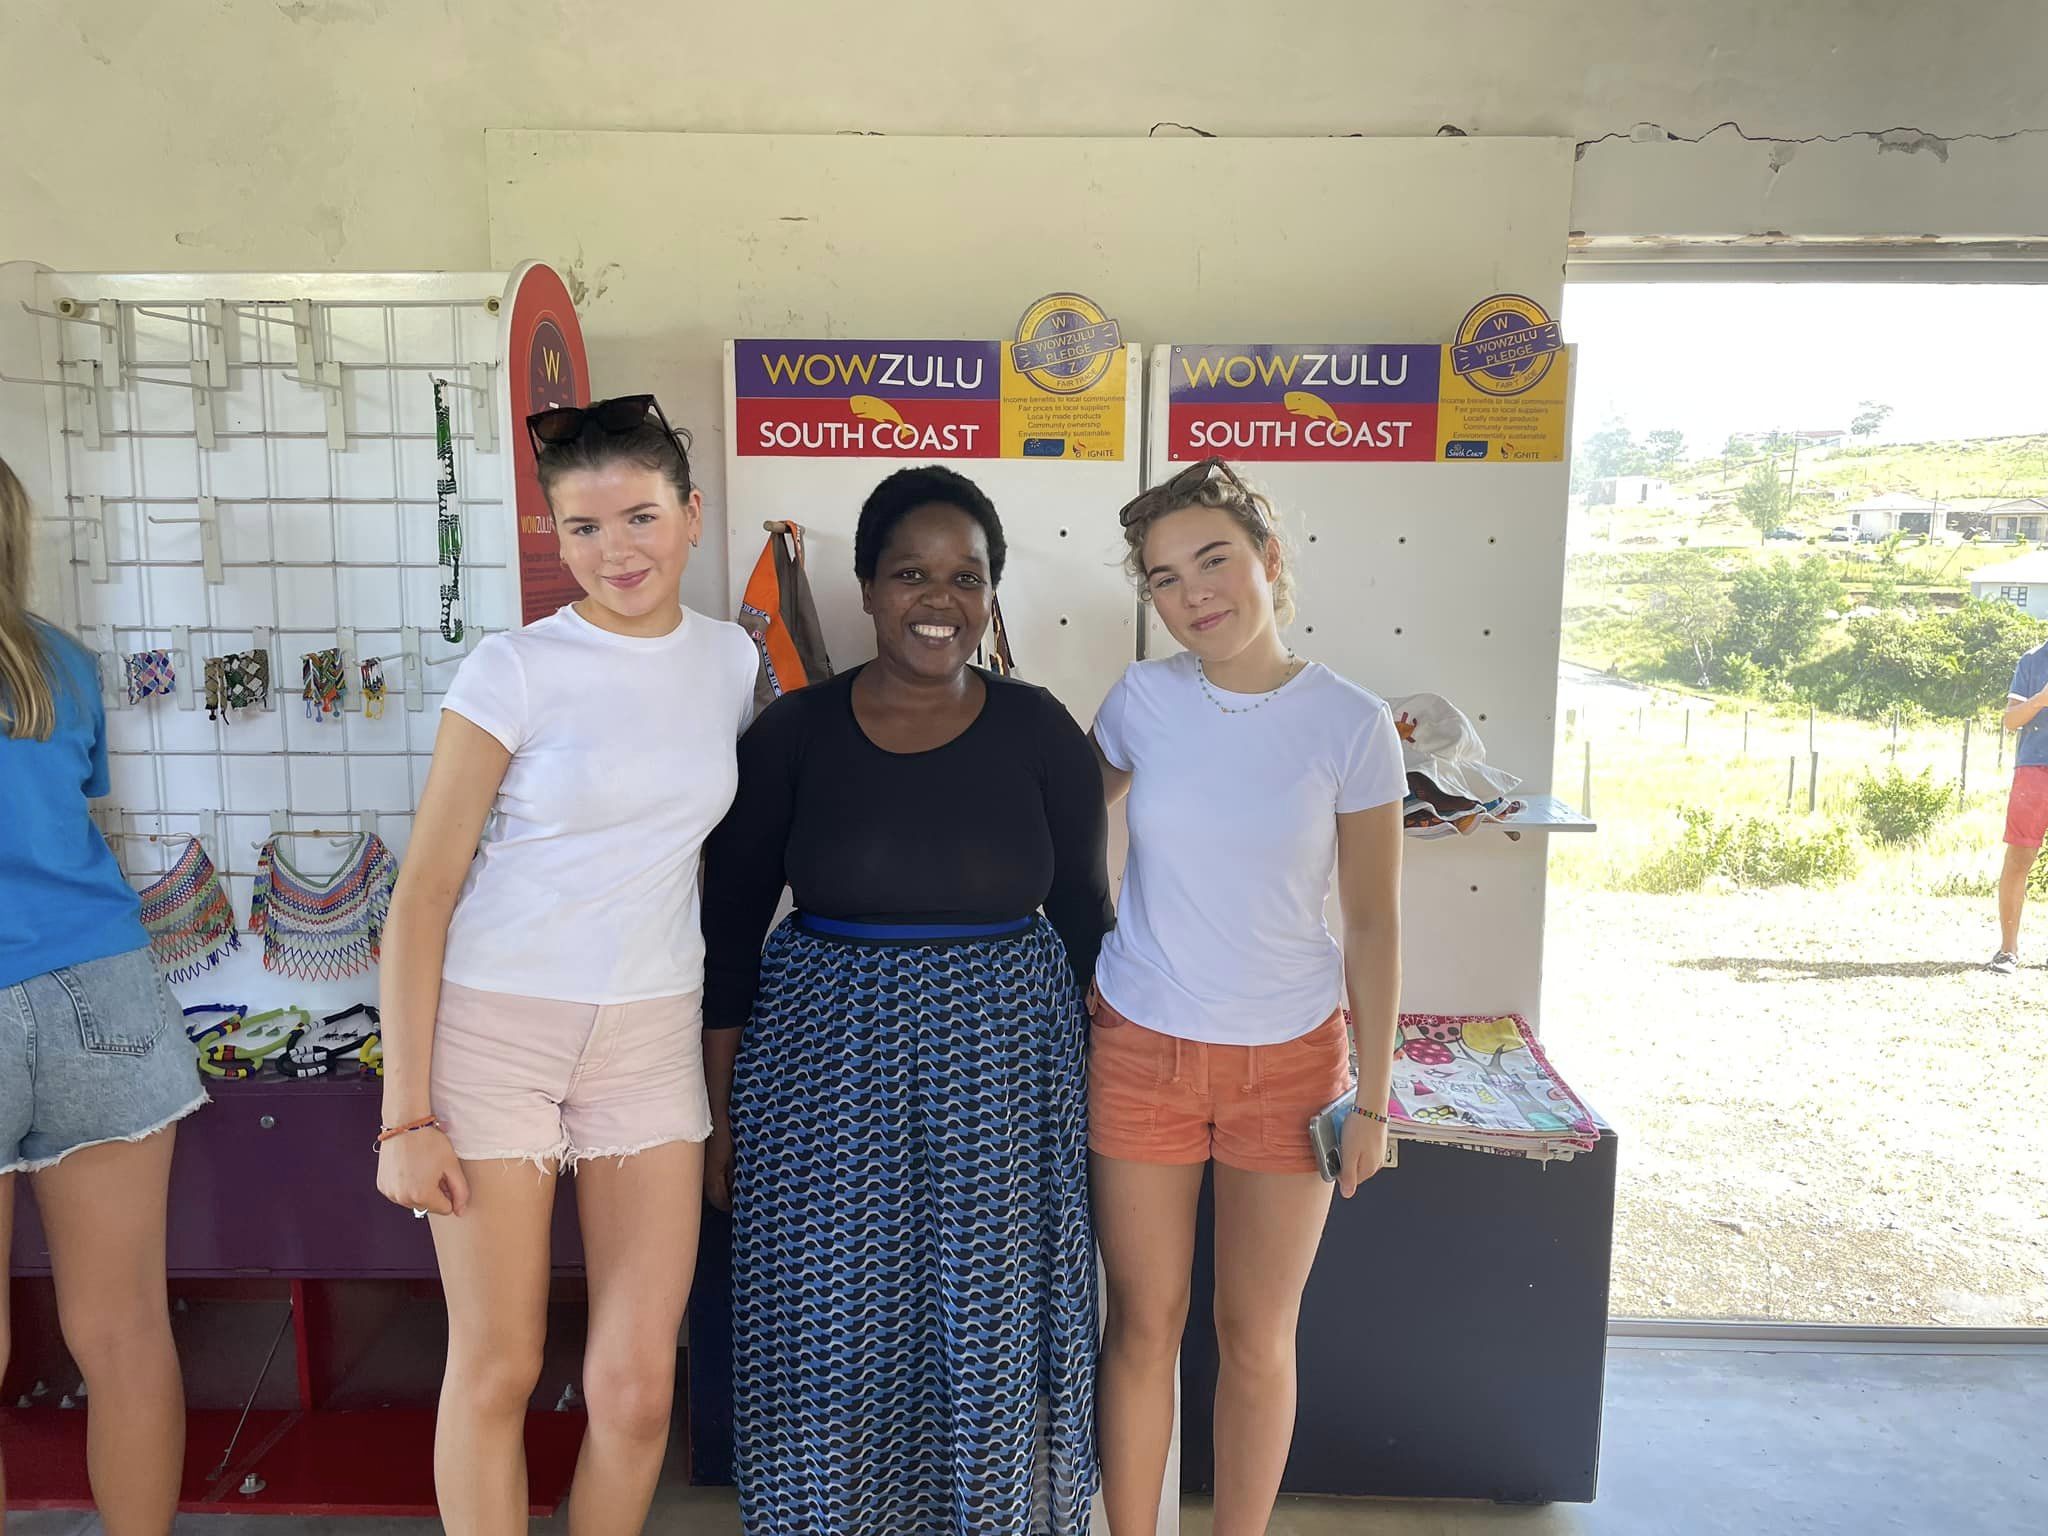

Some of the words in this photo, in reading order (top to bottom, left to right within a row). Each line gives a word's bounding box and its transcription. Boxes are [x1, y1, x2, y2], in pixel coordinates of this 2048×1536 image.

[1051, 314, 1067, 329] W
[1493, 315, 1509, 331] W
[1035, 328, 1096, 353] WOWZULU
[1475, 329, 1538, 354] WOWZULU
[1046, 343, 1093, 363] PLEDGE
[1485, 344, 1534, 365] PLEDGE
[542, 345, 560, 385] W
[761, 353, 983, 389] WOWZULU
[1068, 361, 1079, 374] Z
[1181, 354, 1409, 389] WOWZULU
[1056, 379, 1075, 388] FAIR
[1075, 367, 1097, 385] TRADE
[1495, 380, 1516, 389] FAIR
[1072, 413, 1102, 421] products
[1463, 415, 1487, 423] Locally
[759, 420, 864, 449] SOUTH
[871, 422, 981, 451] COAST
[1189, 420, 1298, 448] SOUTH
[1304, 420, 1413, 448] COAST
[1087, 449, 1115, 458] IGNITE
[1513, 451, 1540, 459] IGNITE
